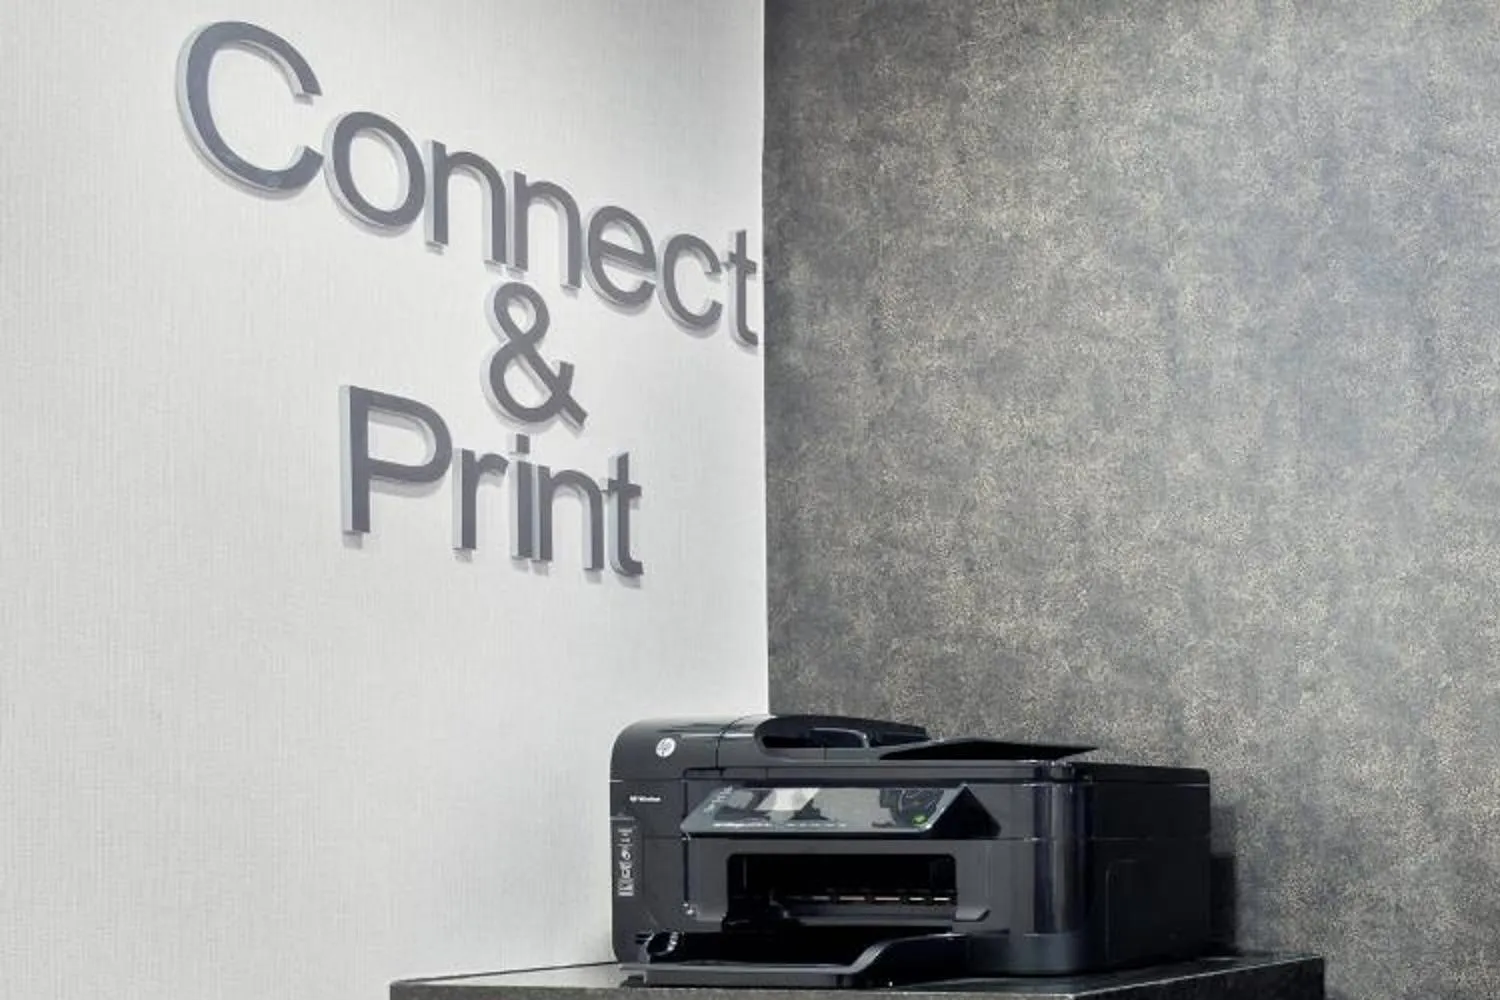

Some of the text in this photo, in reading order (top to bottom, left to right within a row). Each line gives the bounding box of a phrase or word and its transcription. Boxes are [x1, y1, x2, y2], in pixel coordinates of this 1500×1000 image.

[177, 21, 758, 347] Connect
[482, 282, 587, 428] &
[340, 384, 643, 577] Print
